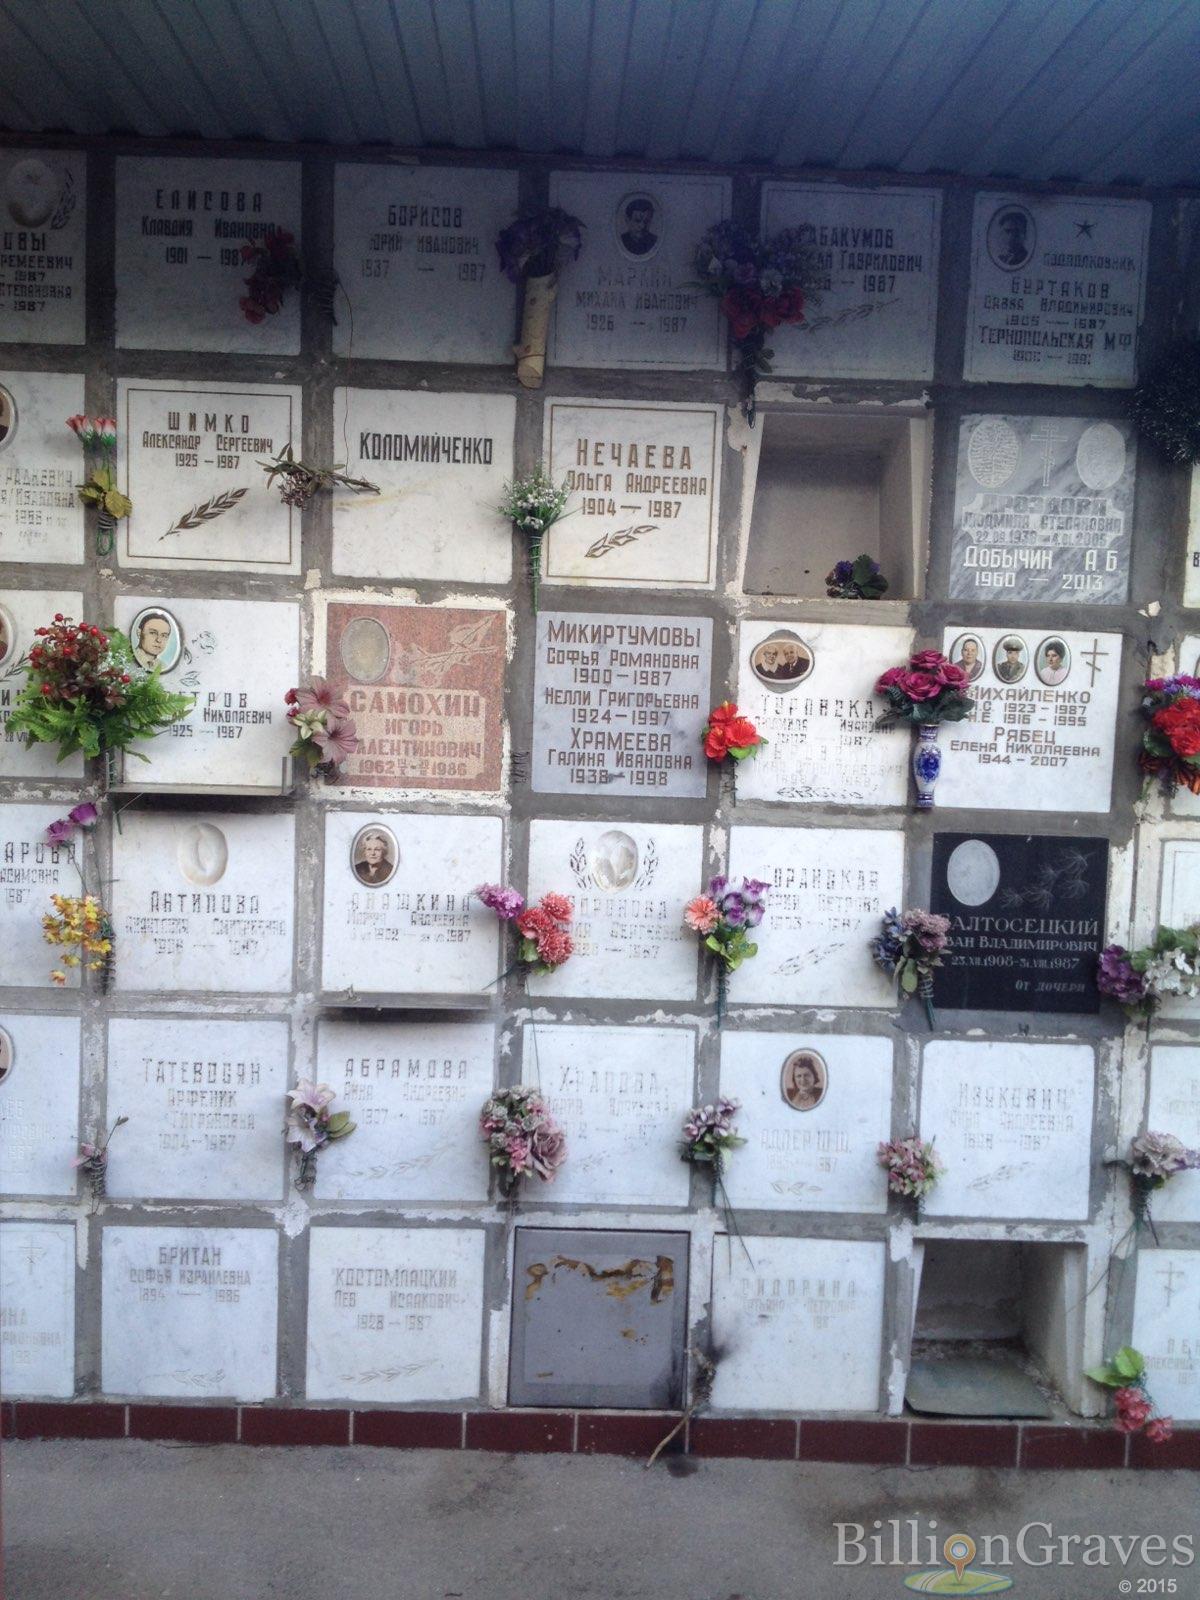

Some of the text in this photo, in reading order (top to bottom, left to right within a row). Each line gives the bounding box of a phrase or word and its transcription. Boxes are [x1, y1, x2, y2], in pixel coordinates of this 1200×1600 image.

[388, 205, 462, 228] БОРИСОВ
[416, 235, 480, 255] ИВАНОВИЧ
[840, 250, 922, 272] ГАВРИЛОВИЧ
[863, 274, 896, 293] 1987
[168, 411, 250, 433] ШИМКО
[142, 431, 274, 453] АЛЕКСАНДР СЕРГЕЕВИЧ
[359, 432, 493, 465] КОЛОМИЙЧЕНКО
[175, 453, 240, 469] 1925 1987
[577, 438, 692, 470] НЕЧАЕВА
[625, 472, 707, 495] АНДРЕЕВНА
[582, 497, 682, 518] 1904 1987
[963, 546, 1053, 569] ДОБЫЧИН
[975, 572, 1103, 590] 1960 2013
[548, 620, 700, 648] МИКИРТУМОВЫ
[547, 647, 700, 670] СОФЬЯ РОМАНОВНА
[574, 668, 672, 687] 1900 1987
[351, 690, 480, 718] САМОХИН
[545, 687, 700, 710] НЕЛЛИ ГРИГОРЬЕВНА
[203, 707, 272, 724] НИКОЛАЕВИЧ
[572, 708, 671, 726] 1924 1997
[1004, 703, 1036, 713] 1923
[1055, 705, 1087, 715] 1987
[385, 718, 443, 736] ИГОРЬ
[1004, 714, 1031, 725] 1916
[1054, 715, 1087, 726] 1995
[217, 725, 243, 739] 1987
[570, 727, 672, 752] ХРАМЕЕВА
[994, 727, 1056, 745] РЯБЕЦ
[356, 739, 482, 758] АЛЕНТИНОВИЧ
[950, 740, 1100, 757] ЕЛЕНА НИКОЛАЕВНА
[548, 749, 692, 770] ГАЛИНА ИВАНОВНА
[978, 754, 1069, 767] 1944 2007
[630, 771, 668, 786] 1998
[150, 890, 259, 914] АНТИПОВА
[947, 914, 1099, 936] АЛТОСЕЦКИЙ
[979, 936, 1098, 952] ВЛАДИМИРОВИЧ
[345, 1058, 467, 1079] АБРАМОВА
[159, 1246, 221, 1266] БРИТАН
[179, 1269, 251, 1286] ИЗРАИЛЕВНА
